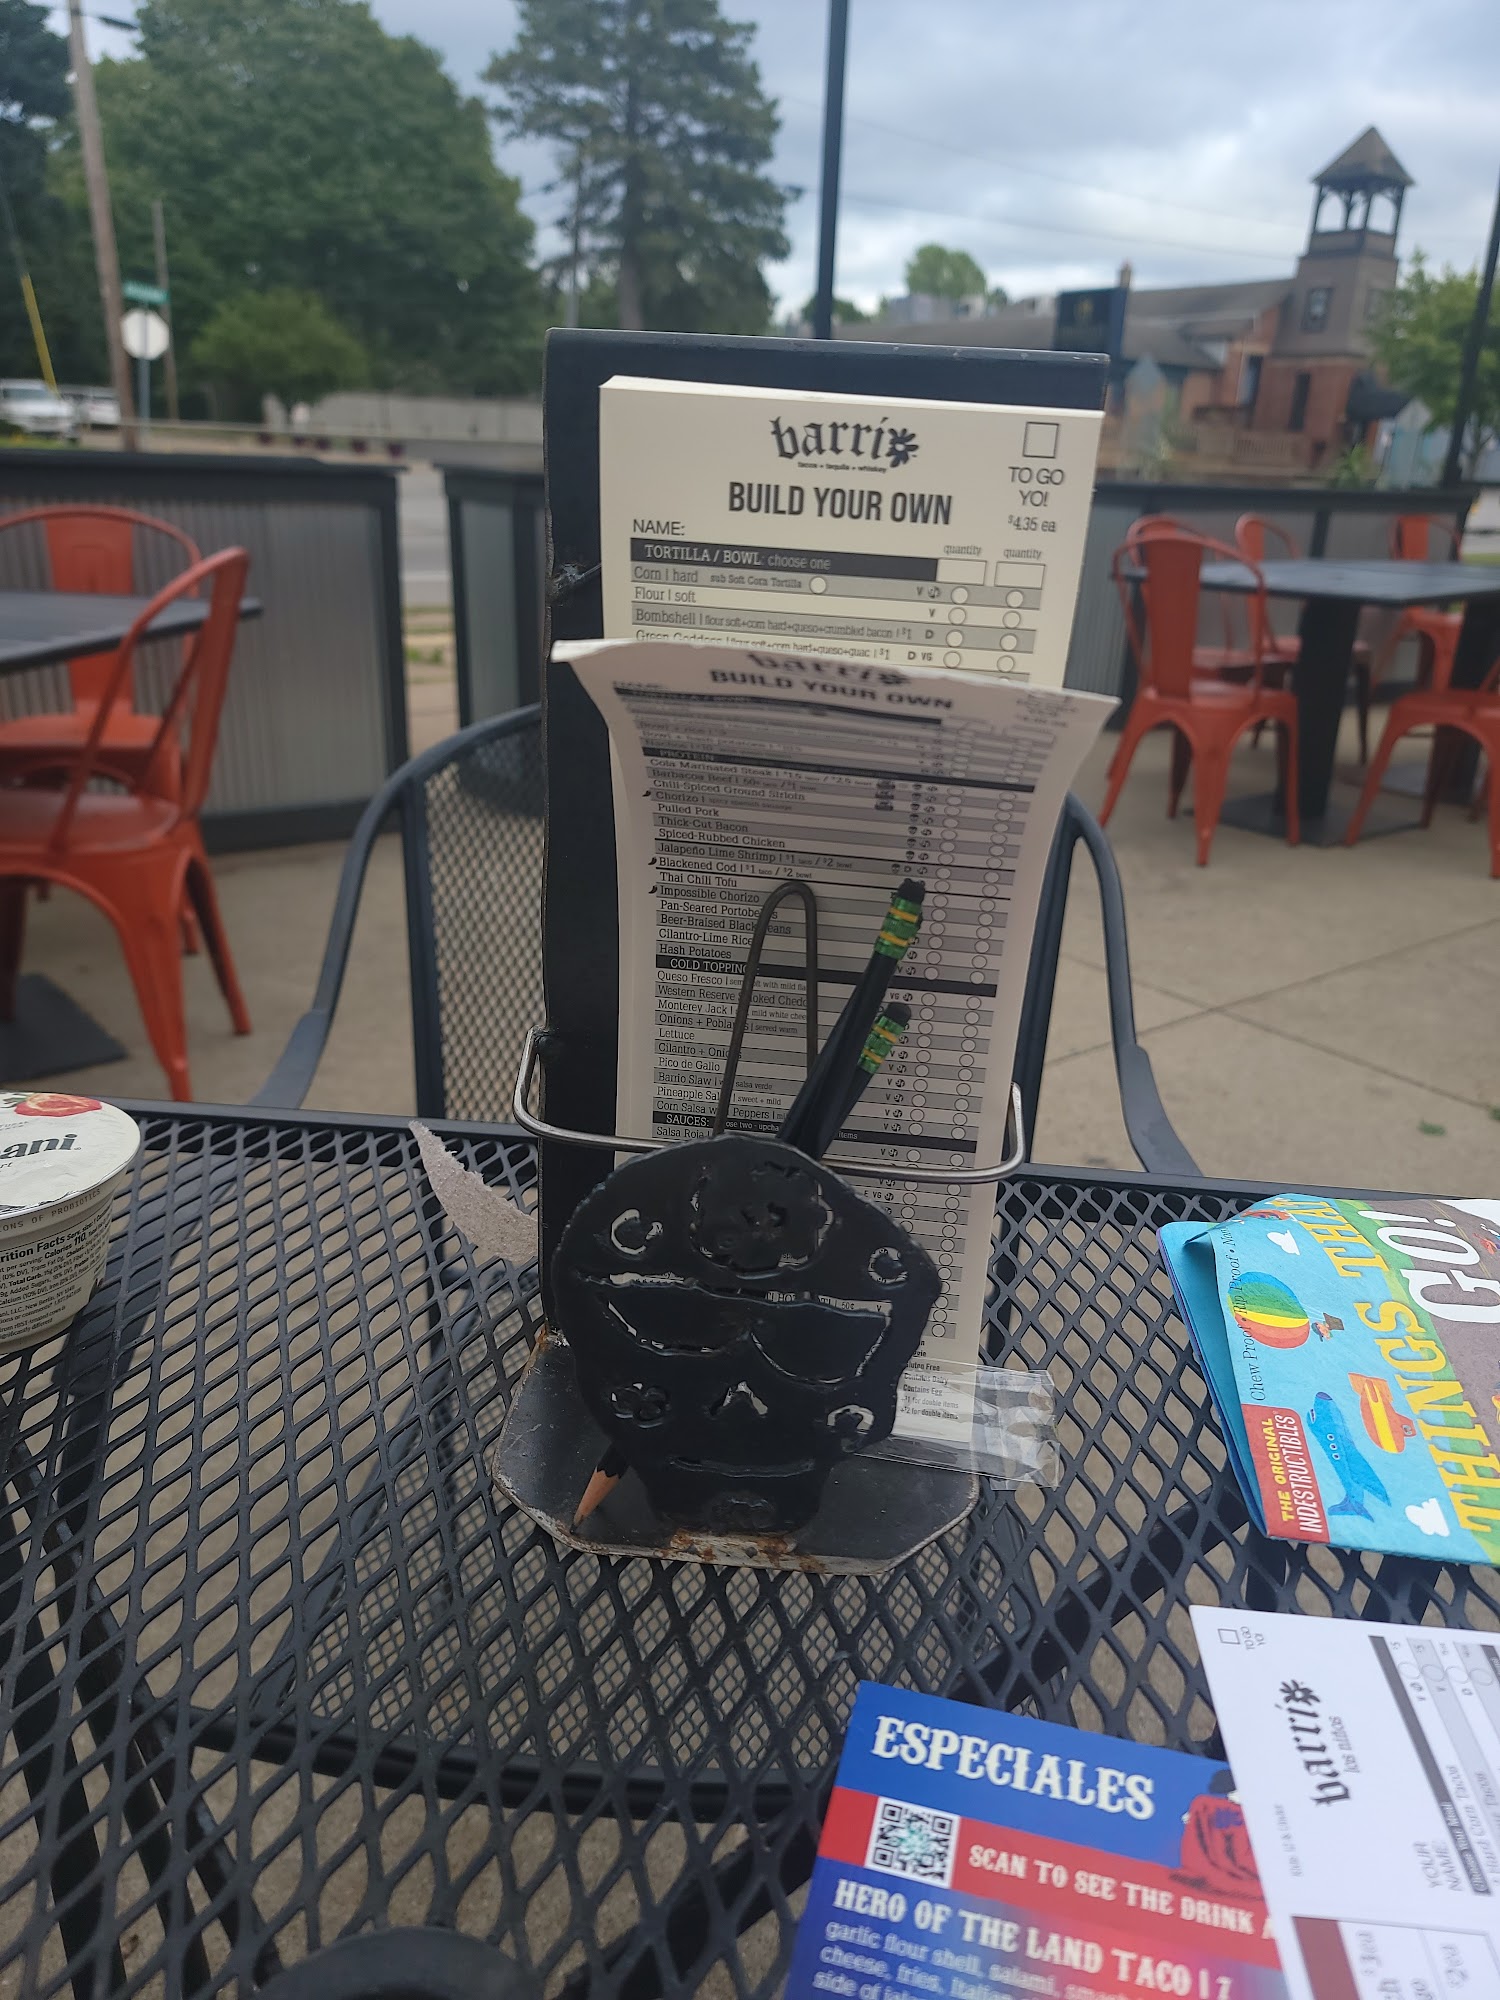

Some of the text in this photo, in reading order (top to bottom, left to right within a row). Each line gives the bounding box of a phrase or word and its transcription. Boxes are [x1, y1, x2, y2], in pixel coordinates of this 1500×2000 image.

[1008, 466, 1065, 486] TO GO
[729, 482, 952, 525] BUILD YOUR OWN
[1019, 490, 1049, 507] YO!
[633, 519, 685, 536] NAME:
[644, 544, 831, 570] TORTILLA BOWL: choose one
[944, 545, 981, 556] quantity
[1003, 548, 1042, 560] quantity
[634, 566, 802, 588] Corn hard sub Soft Corn Tortilla
[635, 587, 696, 603] Flour soft
[636, 608, 892, 639] Bombshell flour bacon
[710, 669, 952, 710] BUILD YOUR OWN
[651, 758, 771, 777] Cola Marinated Steak
[652, 769, 704, 781] Barbacoa
[708, 773, 733, 785] Beef
[653, 779, 720, 794] Chili-Spiced
[723, 785, 765, 799] Ground
[768, 790, 806, 801] Sirloin
[656, 790, 699, 803] Chorizo
[658, 803, 720, 817] Pulled Pork
[659, 816, 749, 833] Thick-Cut Bacon
[658, 828, 786, 848] Spiced-Rubbed Chicken
[658, 842, 776, 864] Jalapeño Lime Shrimp
[659, 857, 812, 880] Blackened Cod taco bowl
[660, 872, 738, 888] Thai Chili Tofu
[660, 885, 760, 903] Impossible Chorizo
[660, 901, 718, 915] Pan-Seared
[660, 914, 756, 932] Beer-Braised Black
[658, 928, 753, 946] Cilantro-Lime Rice
[659, 943, 732, 960] Hash Potatoes
[670, 959, 700, 970] COLD
[657, 970, 796, 991] Queso Fresco mild
[657, 985, 736, 1001] Western Reserve
[657, 1000, 789, 1020] Monterey Jack mild white
[659, 1013, 797, 1034] Onions served warm
[659, 1028, 695, 1041] Lettuce
[658, 1042, 696, 1055] Cilantro
[659, 1057, 720, 1072] Pico de Gallo
[658, 1072, 773, 1091] Barrio Slaw salsa verde
[656, 1086, 782, 1106] Pineapple sweet mild
[656, 1100, 679, 1111] Corn
[681, 1102, 705, 1114] Salsa
[733, 1107, 769, 1119] Peppers
[656, 1127, 681, 1138] Salsa
[666, 1114, 710, 1127] SAUCES:
[838, 1130, 858, 1140] items
[31, 1188, 101, 1223] OF PROBIOTICS
[37, 1235, 66, 1253] Facts
[7, 1264, 17, 1273] per
[44, 1244, 73, 1260] Calories
[1357, 1210, 1500, 1324] GO!
[9, 1278, 26, 1287] Total
[1226, 1251, 1267, 1402] Chew Proof Rip Proof
[925, 1363, 941, 1371] Free
[1271, 1201, 1500, 1533] THINGS THAT
[903, 1384, 943, 1397] Contains Egg
[921, 1399, 959, 1409] double items
[1261, 1418, 1295, 1522] THE ORIGINAL
[871, 1714, 1155, 1822] ESPECIALES
[1341, 1752, 1361, 1775] los
[1445, 1763, 1471, 1801] Tacos
[1412, 1840, 1443, 1888] YOUR
[968, 1844, 1027, 1880] SCAN
[1034, 1858, 1069, 1888] TO
[1074, 1870, 1118, 1902] SEE
[1122, 1880, 1176, 1916] THE
[1180, 1896, 1255, 1936] DRINK
[825, 1921, 883, 1950] garlic
[884, 1932, 930, 1963] flour
[833, 1878, 907, 1923] HERO
[914, 1899, 952, 1935] OF
[957, 1909, 1021, 1954] THE
[1026, 1927, 1104, 1974] LAND
[1111, 1946, 1193, 1997] TACO
[819, 1944, 893, 1981] cheese,
[811, 1970, 858, 1998] side
